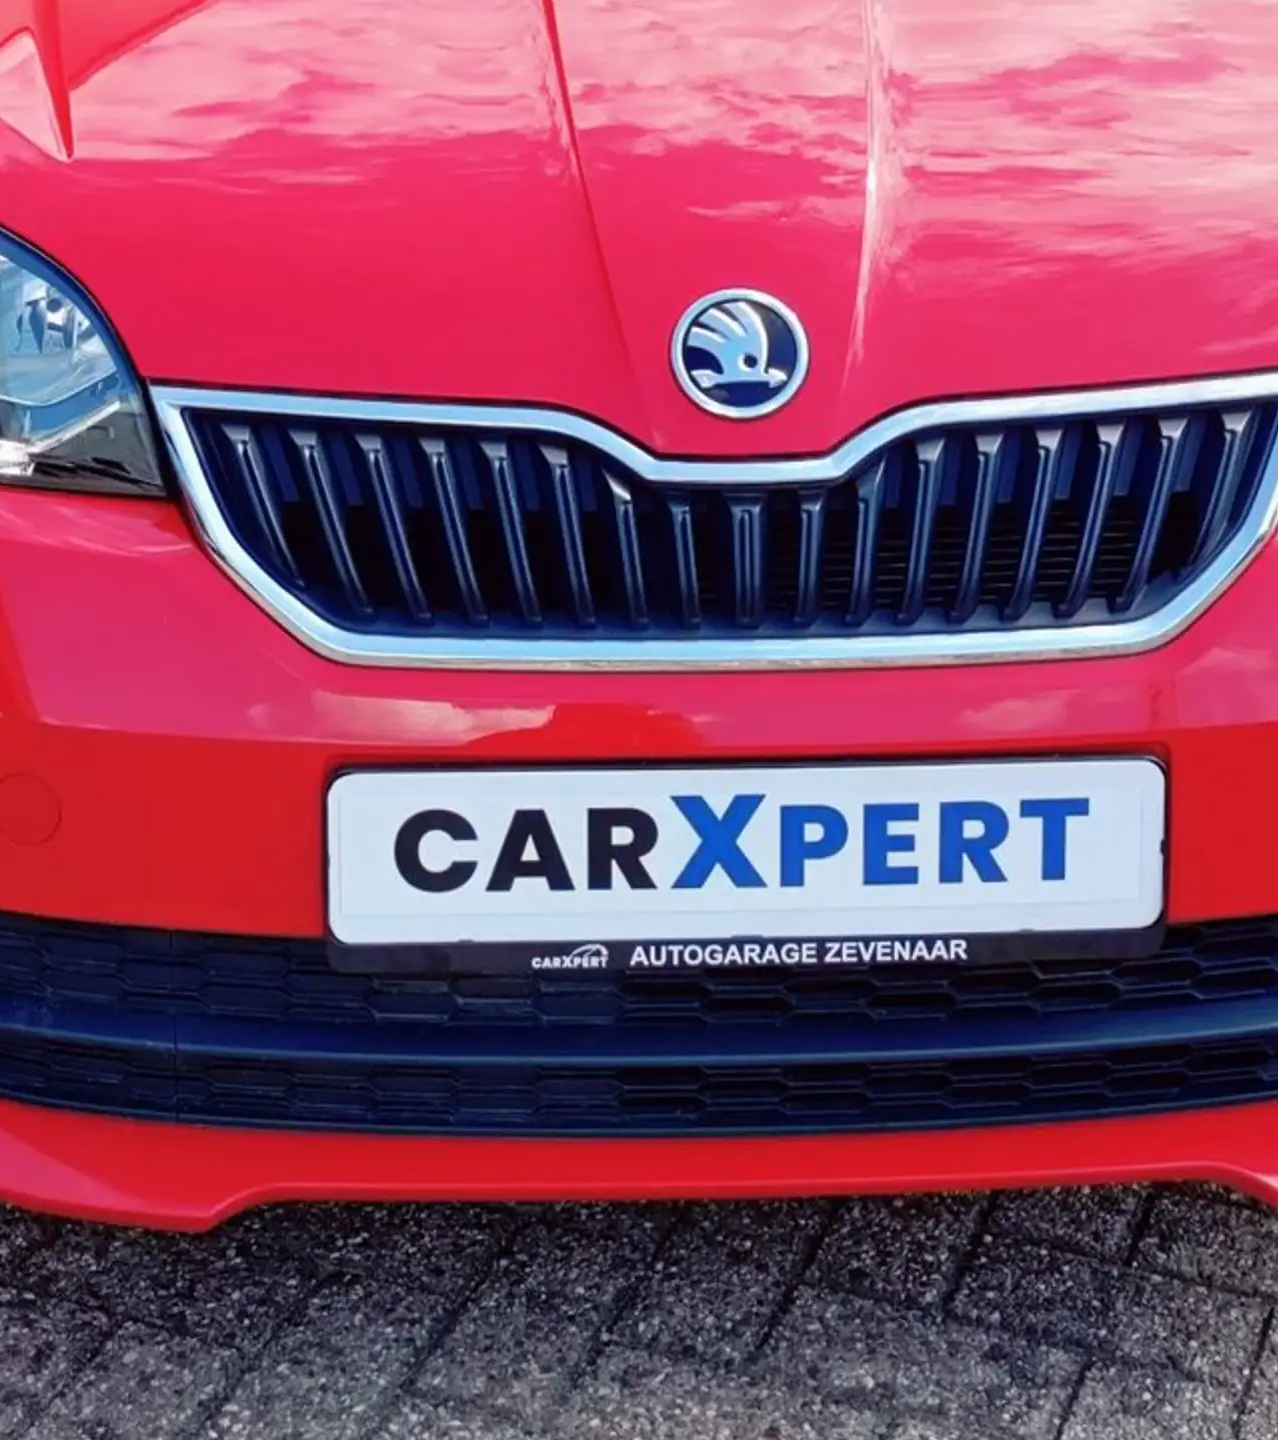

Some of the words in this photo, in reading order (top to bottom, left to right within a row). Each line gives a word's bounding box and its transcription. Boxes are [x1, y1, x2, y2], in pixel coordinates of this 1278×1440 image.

[394, 793, 1091, 893] CARXPERT
[531, 948, 609, 970] CARXPERT
[630, 941, 818, 967] AUTOGARAGE
[823, 937, 968, 964] ZEVENAAR
